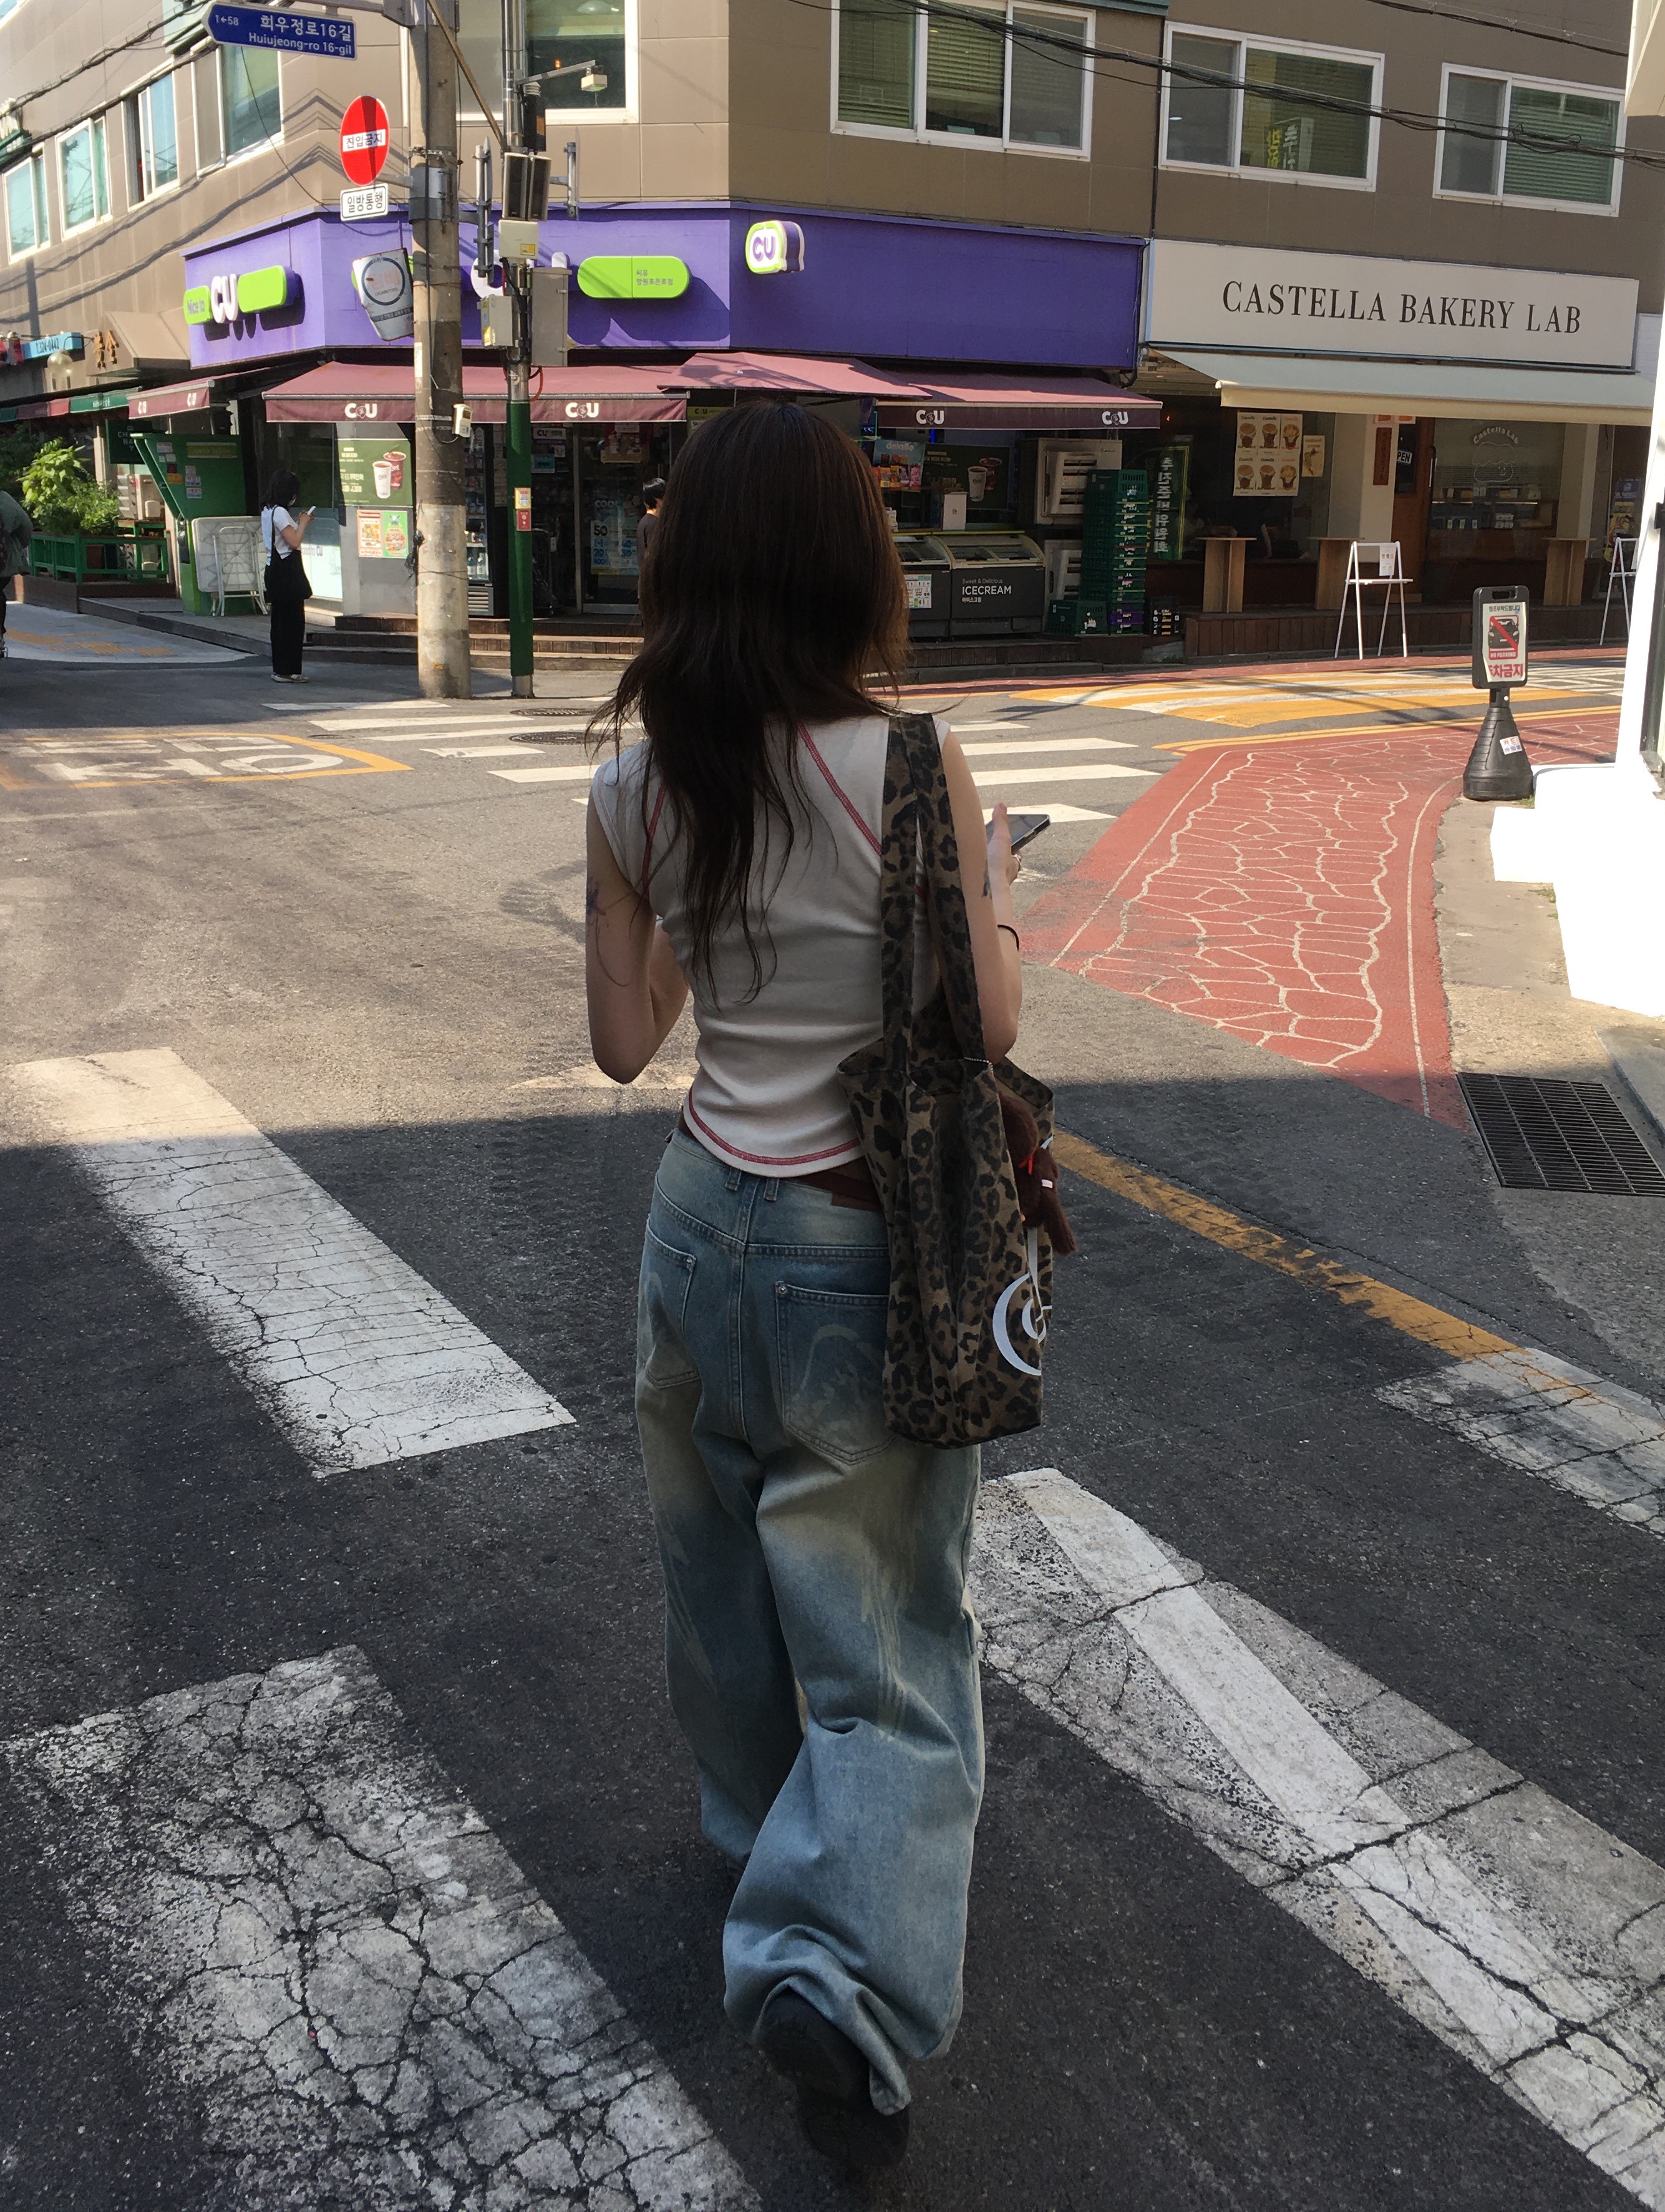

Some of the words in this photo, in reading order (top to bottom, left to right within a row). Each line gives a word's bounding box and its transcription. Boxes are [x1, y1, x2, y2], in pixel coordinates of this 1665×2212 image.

[260, 14, 351, 42] 희우정로16길
[249, 32, 319, 51] Huiujeong-ro
[323, 42, 352, 56] 16-gil
[346, 132, 382, 148] 진입금지
[347, 191, 383, 213] 일방통행
[752, 236, 776, 261] CU
[211, 273, 238, 324] CU
[1222, 280, 1386, 322] CASTELLA
[1399, 293, 1515, 329] BAKERY
[1525, 304, 1581, 334] LAB
[344, 402, 377, 419] CU
[565, 402, 599, 418] CU
[916, 409, 944, 425] CU
[1102, 410, 1129, 425] CU
[1473, 426, 1506, 444] Castella
[1506, 429, 1519, 444] Lab
[1397, 452, 1410, 463] PEN
[962, 585, 1011, 595] ICECREAM
